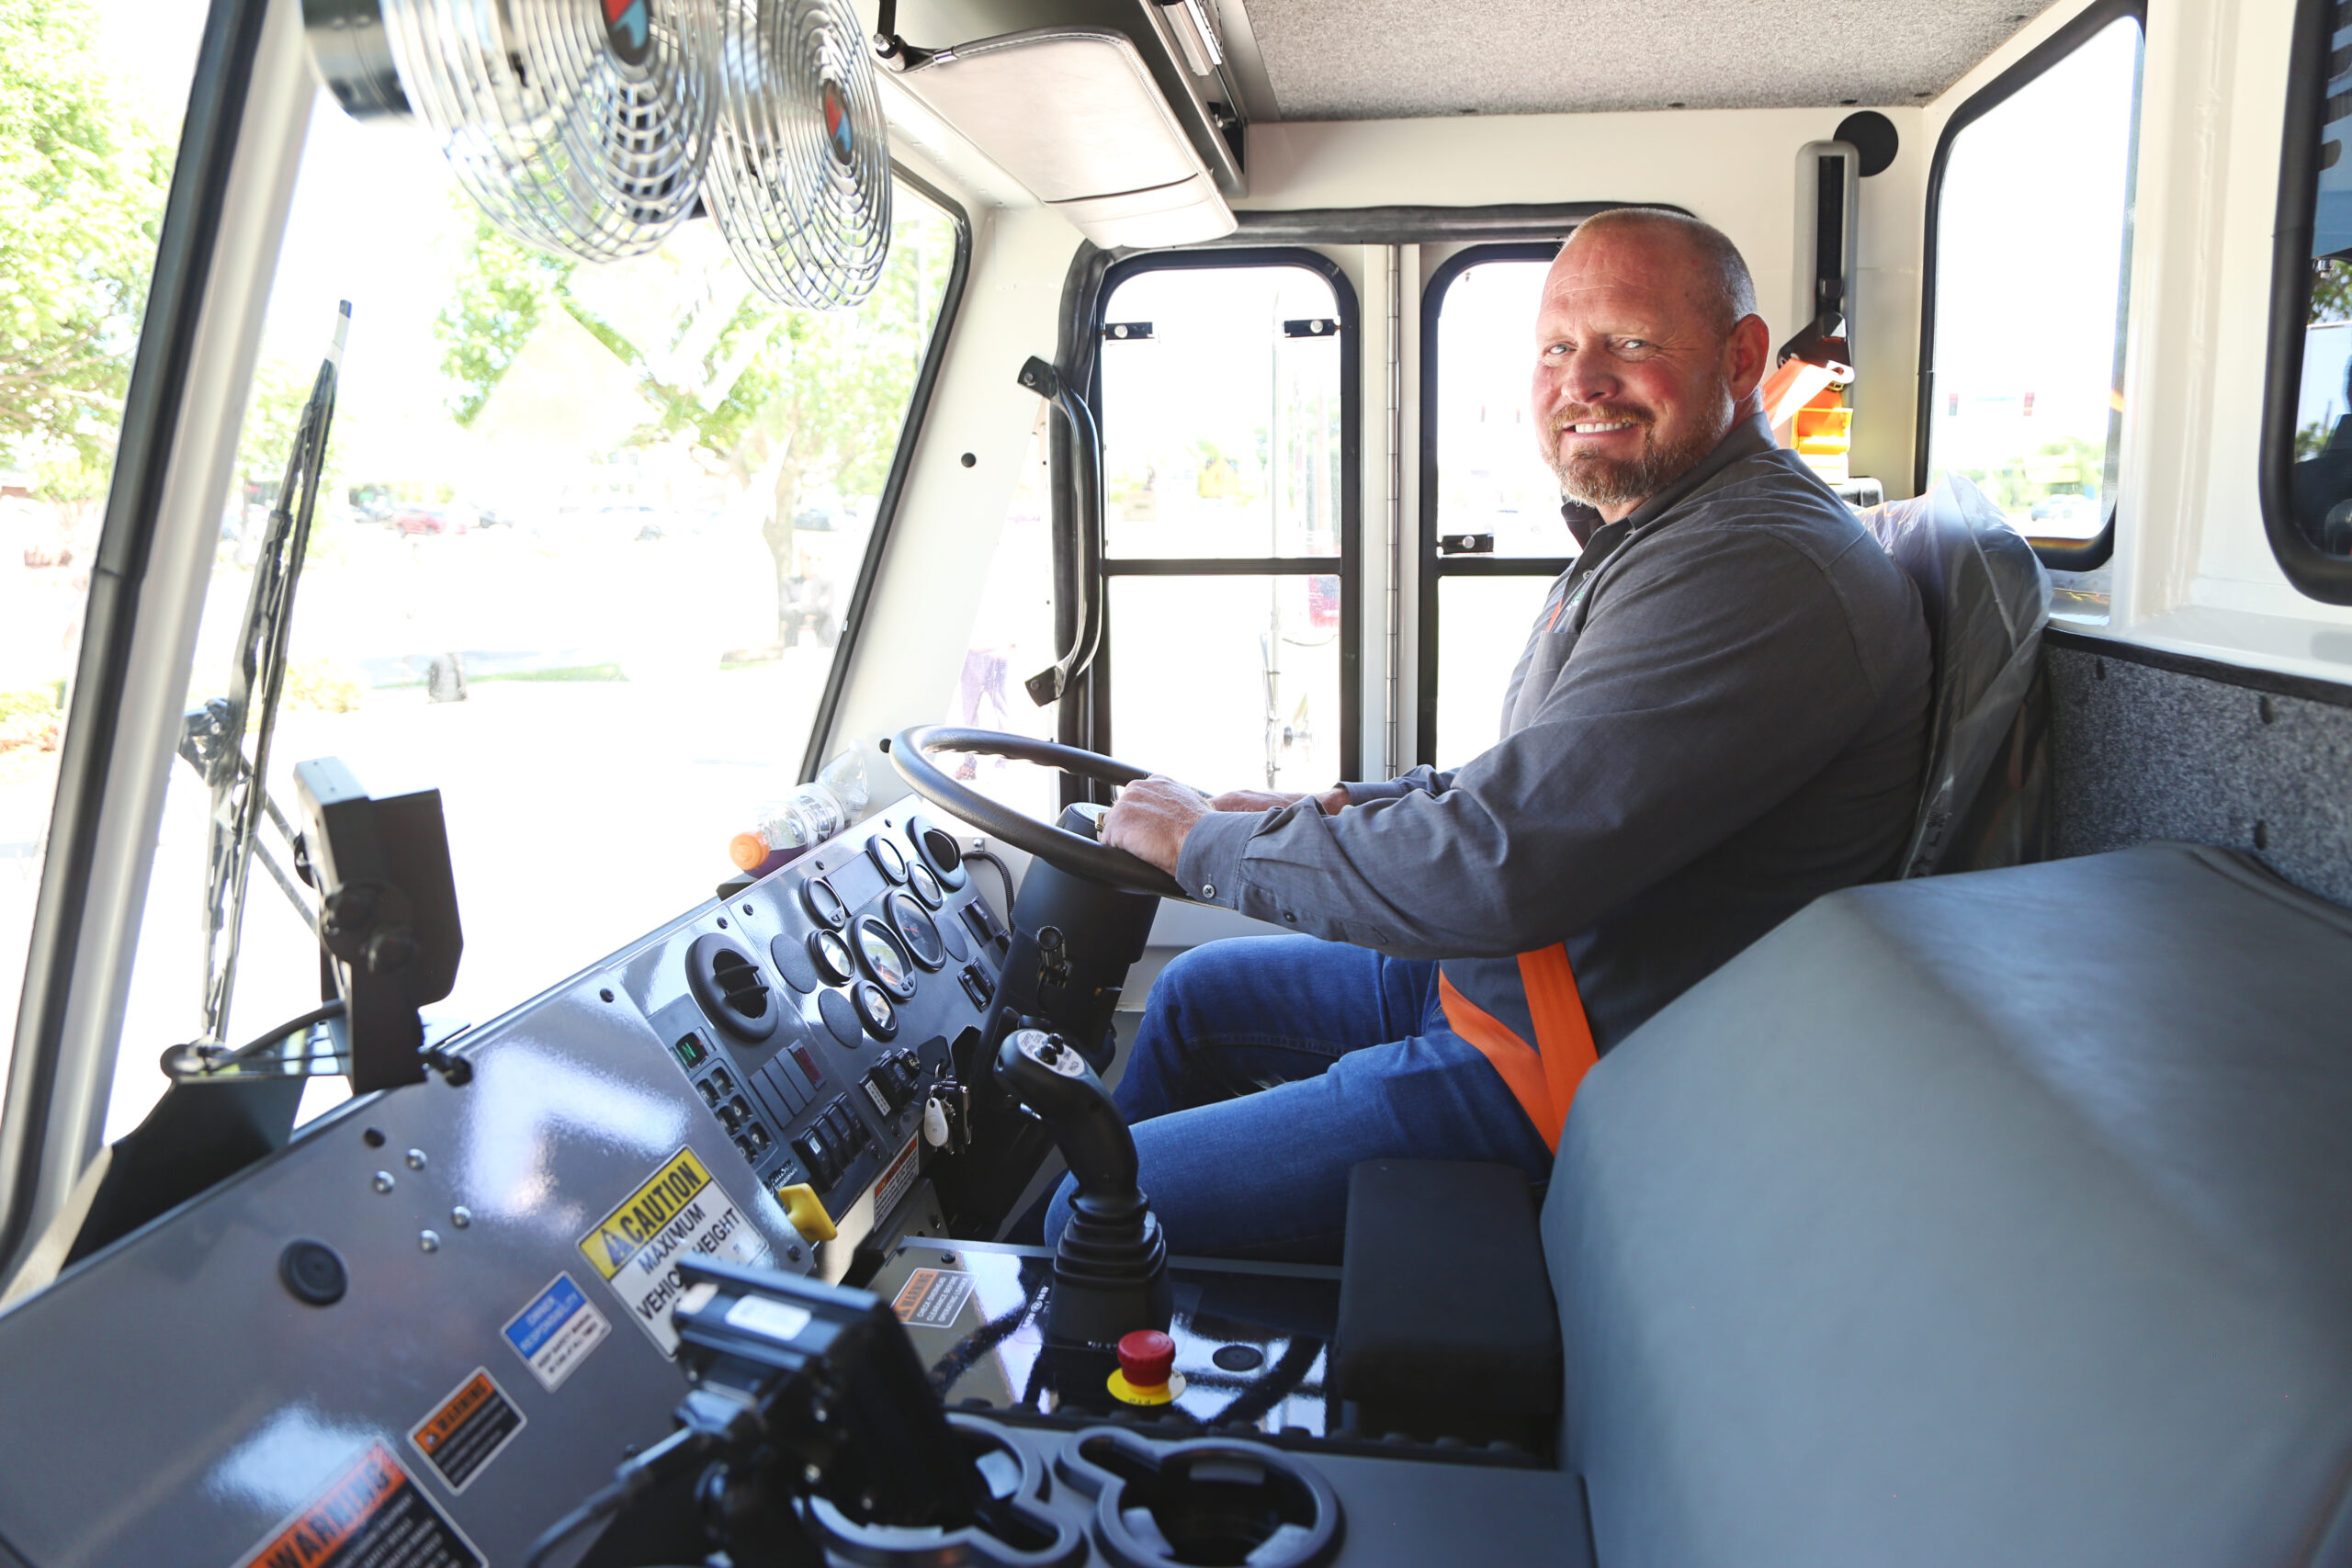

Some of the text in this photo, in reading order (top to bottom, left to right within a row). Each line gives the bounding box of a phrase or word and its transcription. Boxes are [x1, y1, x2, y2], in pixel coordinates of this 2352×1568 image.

[620, 1161, 701, 1239] CAUTION
[638, 1202, 706, 1275] MAXIMUM
[637, 1269, 684, 1320] VEHIC
[900, 1274, 933, 1307] WARNING
[266, 1461, 390, 1568] WARNING
